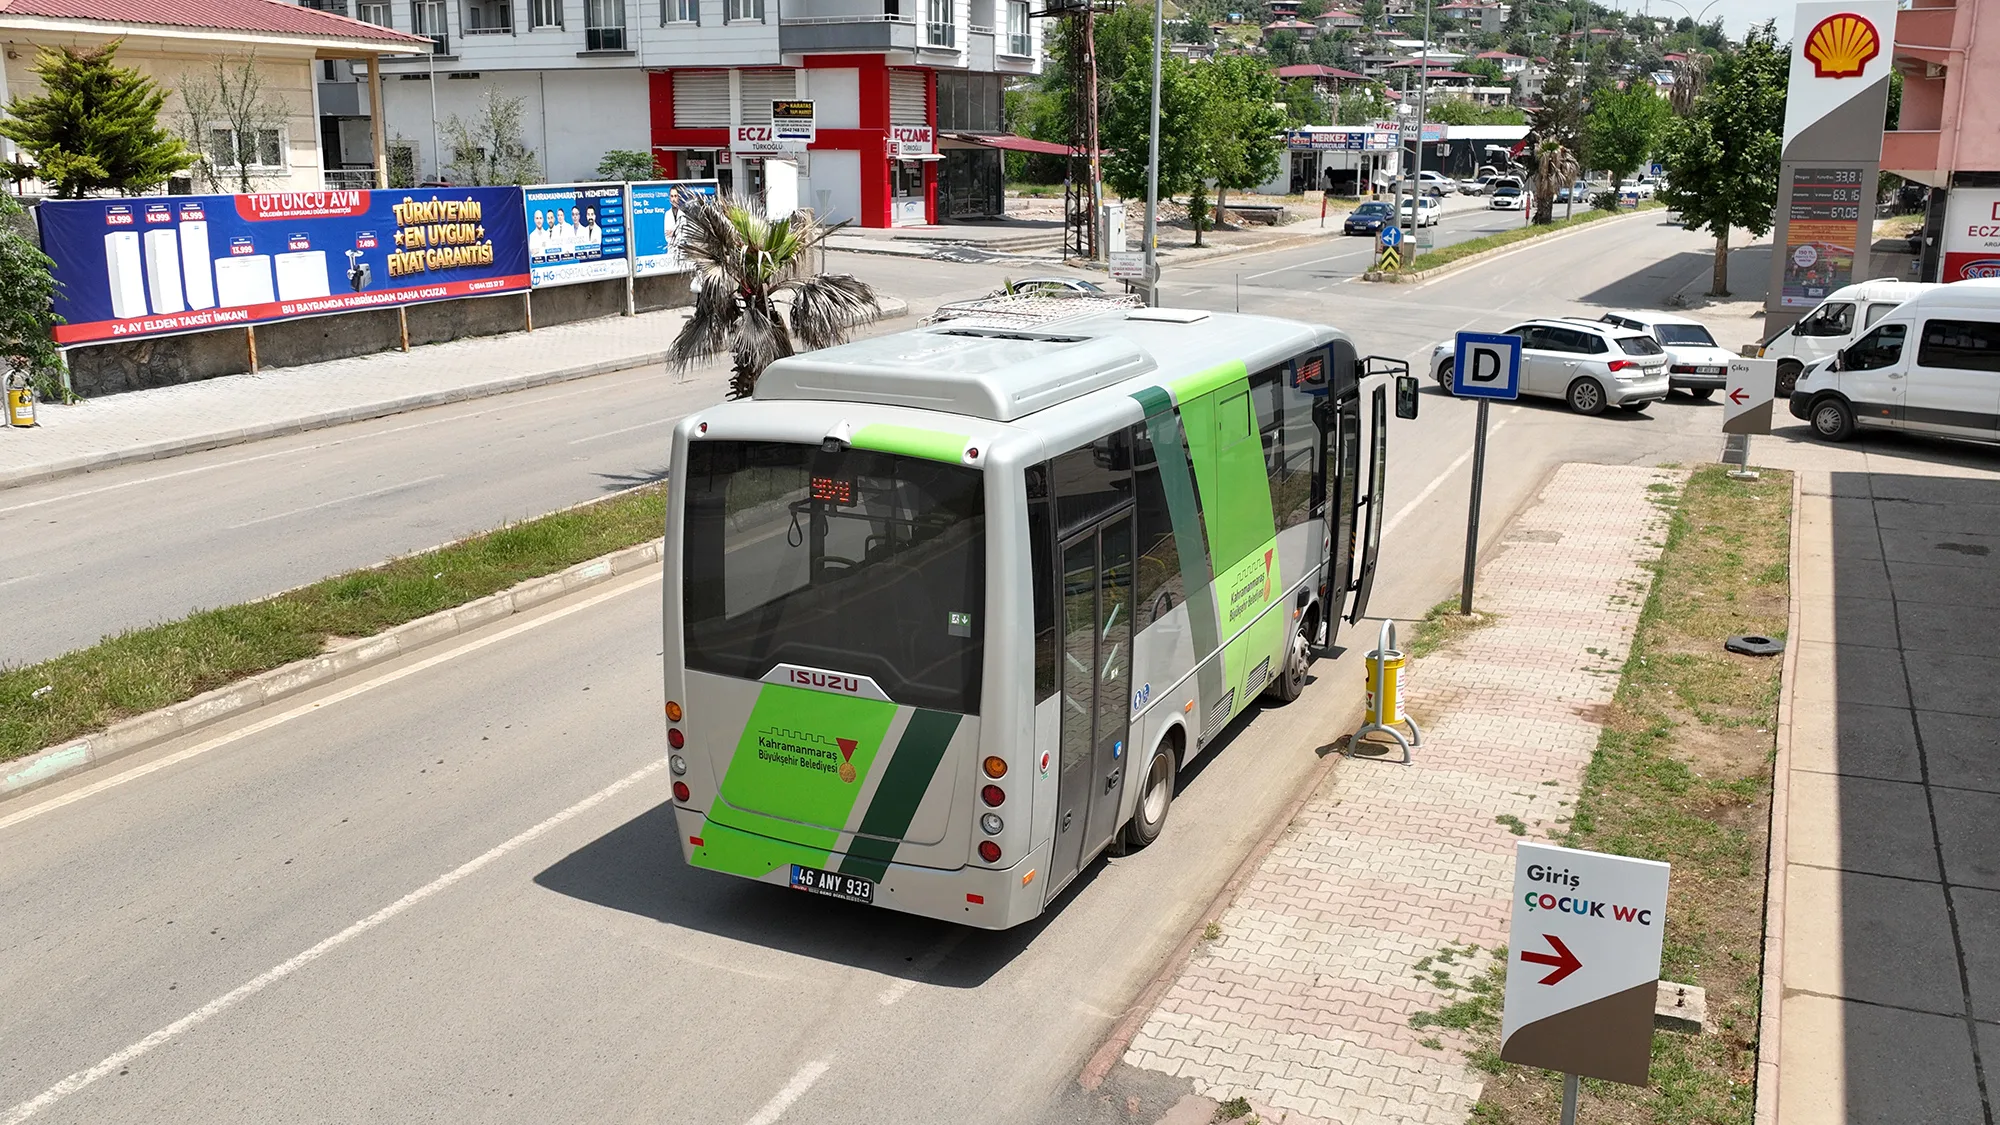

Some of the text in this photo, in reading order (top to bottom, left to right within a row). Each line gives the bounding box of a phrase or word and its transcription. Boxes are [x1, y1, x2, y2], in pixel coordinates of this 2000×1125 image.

[737, 127, 772, 141] ECZA
[894, 128, 931, 142] ECZANE
[1311, 133, 1346, 142] MERKEZ
[752, 142, 783, 150] TÜRKOĞLU
[721, 152, 729, 163] E
[1835, 171, 1862, 184] 33,81
[248, 191, 360, 211] TÜTÜNCÜ AVM
[1832, 189, 1860, 201] 69,16
[146, 213, 170, 222] 14.999
[180, 212, 204, 220] 16.999
[393, 195, 482, 227] TÜRKİYE'NİN
[107, 215, 132, 224] 13.999
[404, 223, 476, 249] EN UYGUN
[1968, 225, 2000, 237] ECZ
[232, 246, 253, 254] 13.999
[358, 239, 375, 247] 7.499
[387, 239, 494, 277] FİYAT GARANTİSİ
[644, 259, 656, 268] HG
[543, 270, 555, 280] HG
[556, 267, 585, 279] HOSPITAL
[281, 287, 447, 314] BU BAYRAMDA FABRİKADAN DAHA UCUZA!
[112, 310, 249, 335] 24 AY ELDEN TAKSİT İMKANI
[1472, 347, 1501, 382] D
[1731, 363, 1750, 373] Çıkış
[790, 669, 858, 692] ISUZU
[758, 736, 838, 763] Kahramanmaraş
[758, 749, 838, 774] Büyükşehir Belediyesi
[799, 868, 870, 898] 46 ANY 933
[1526, 864, 1580, 892] Giriş
[1524, 891, 1652, 926] ÇOCUK WC
